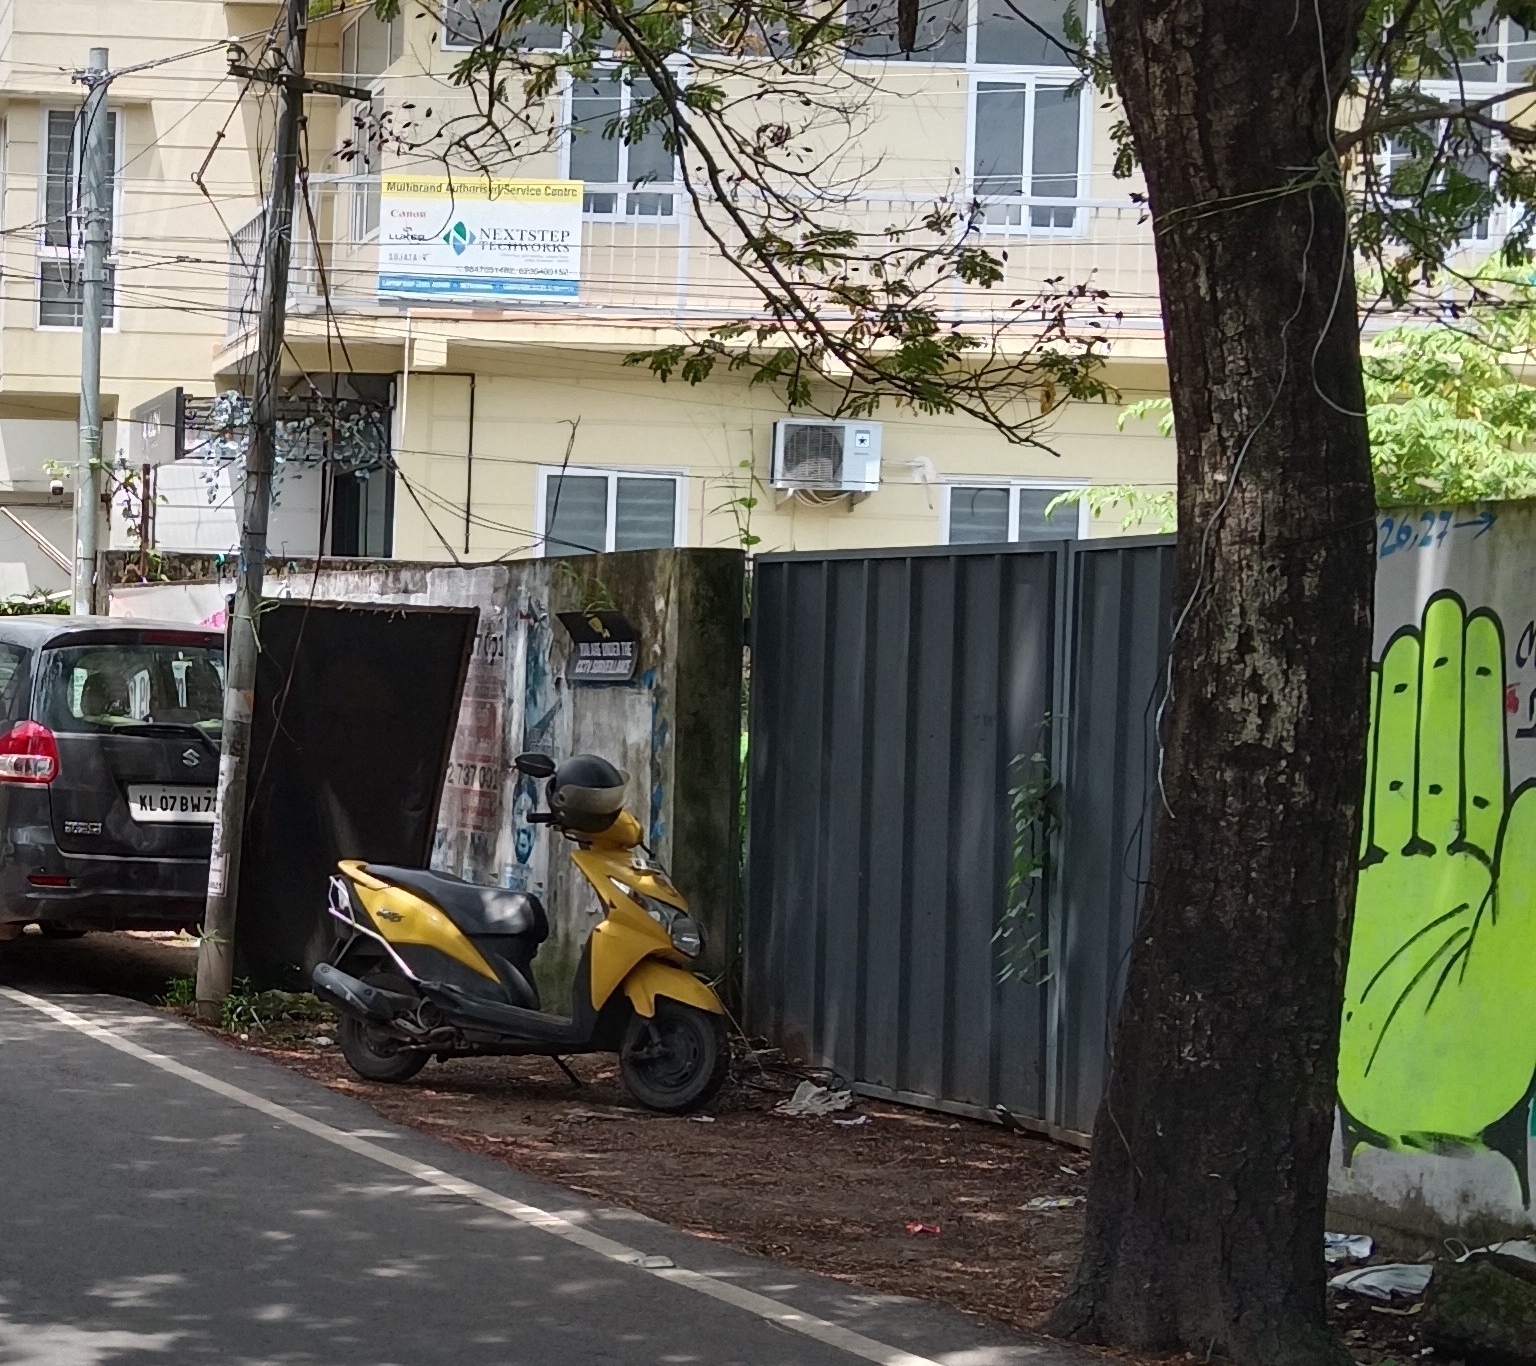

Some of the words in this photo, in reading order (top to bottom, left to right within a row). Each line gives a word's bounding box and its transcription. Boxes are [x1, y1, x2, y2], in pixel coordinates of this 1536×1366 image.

[386, 181, 442, 194] Multibrand
[479, 227, 570, 243] NEXTSTEP
[479, 240, 570, 253] TECHWORKS
